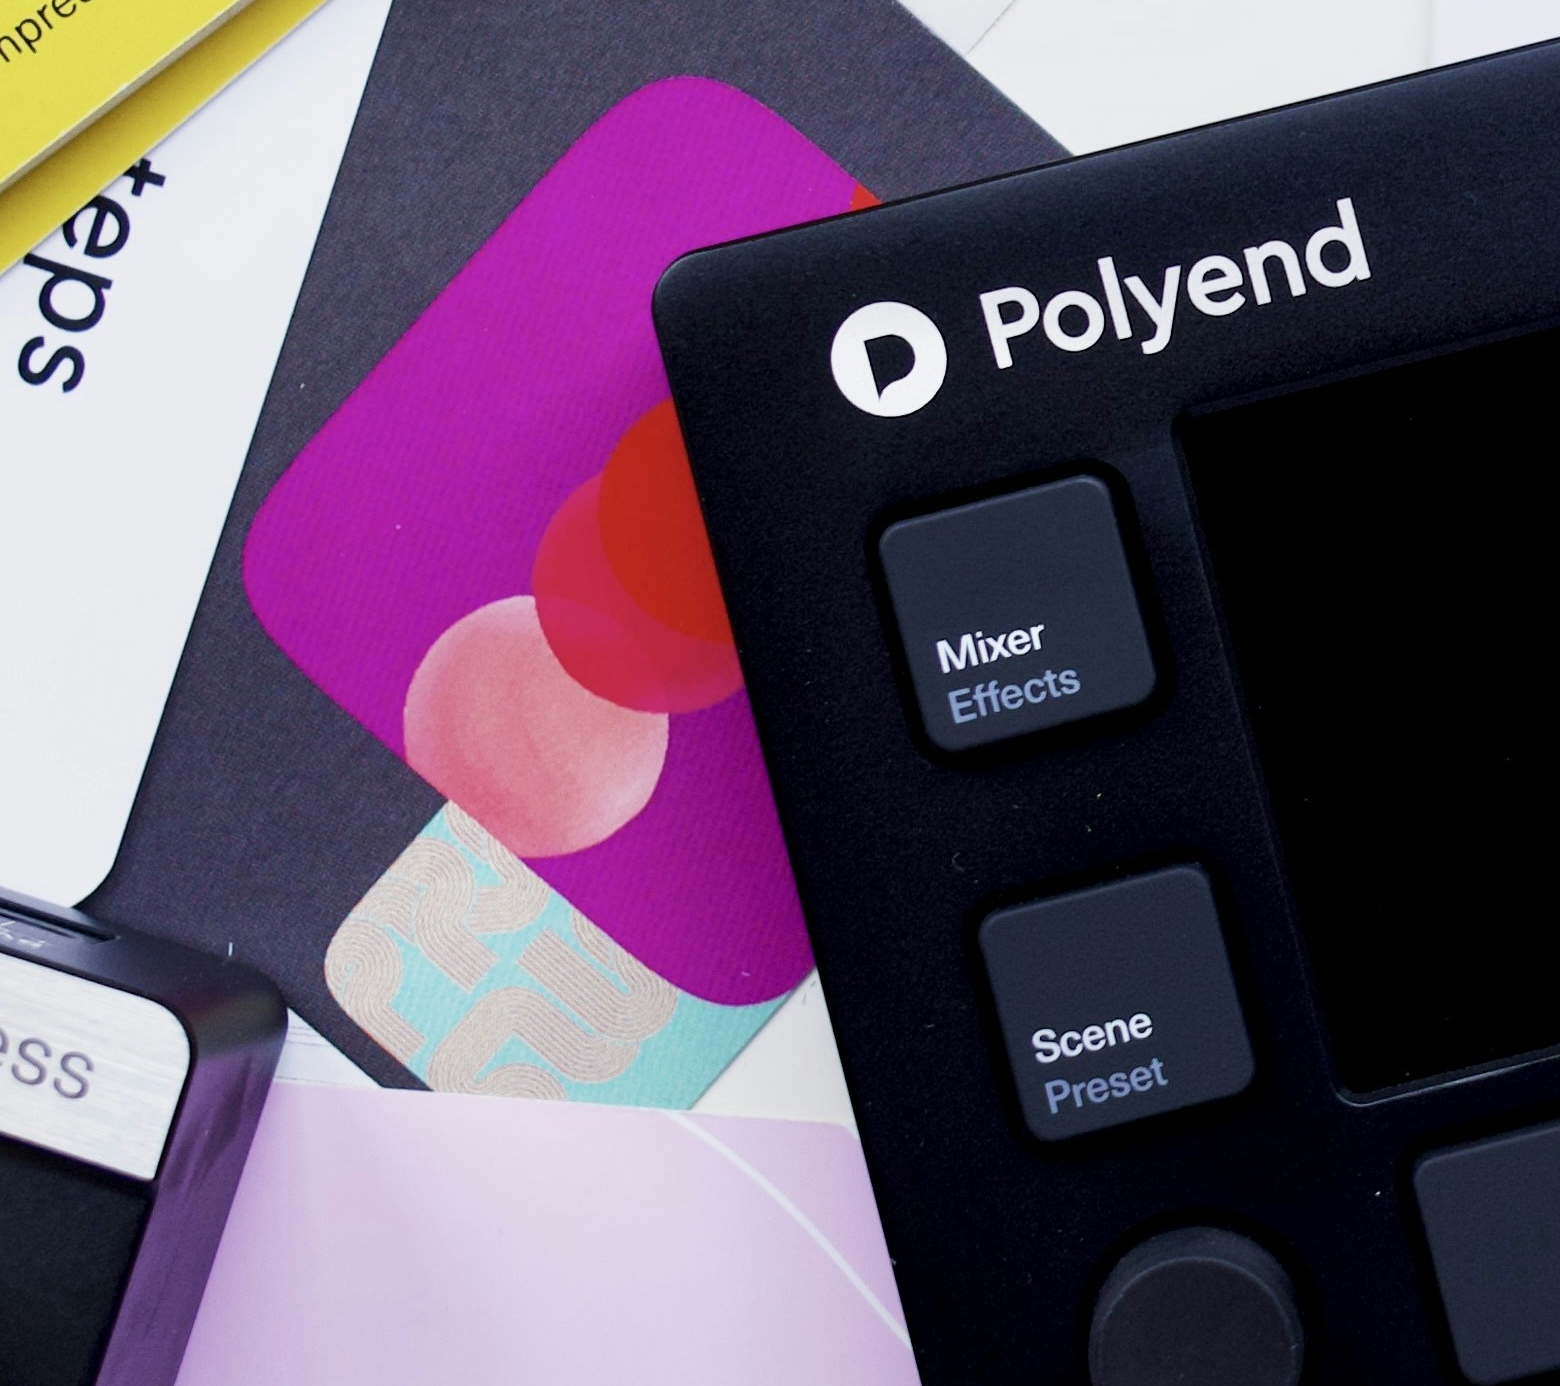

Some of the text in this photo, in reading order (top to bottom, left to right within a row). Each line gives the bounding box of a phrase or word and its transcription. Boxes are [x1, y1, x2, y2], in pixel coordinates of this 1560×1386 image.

[978, 196, 1372, 370] Polyend
[935, 623, 1045, 674] Mixer
[947, 668, 1081, 724] Effects
[1031, 1012, 1153, 1064] Scene
[1043, 1057, 1169, 1115] Preset
